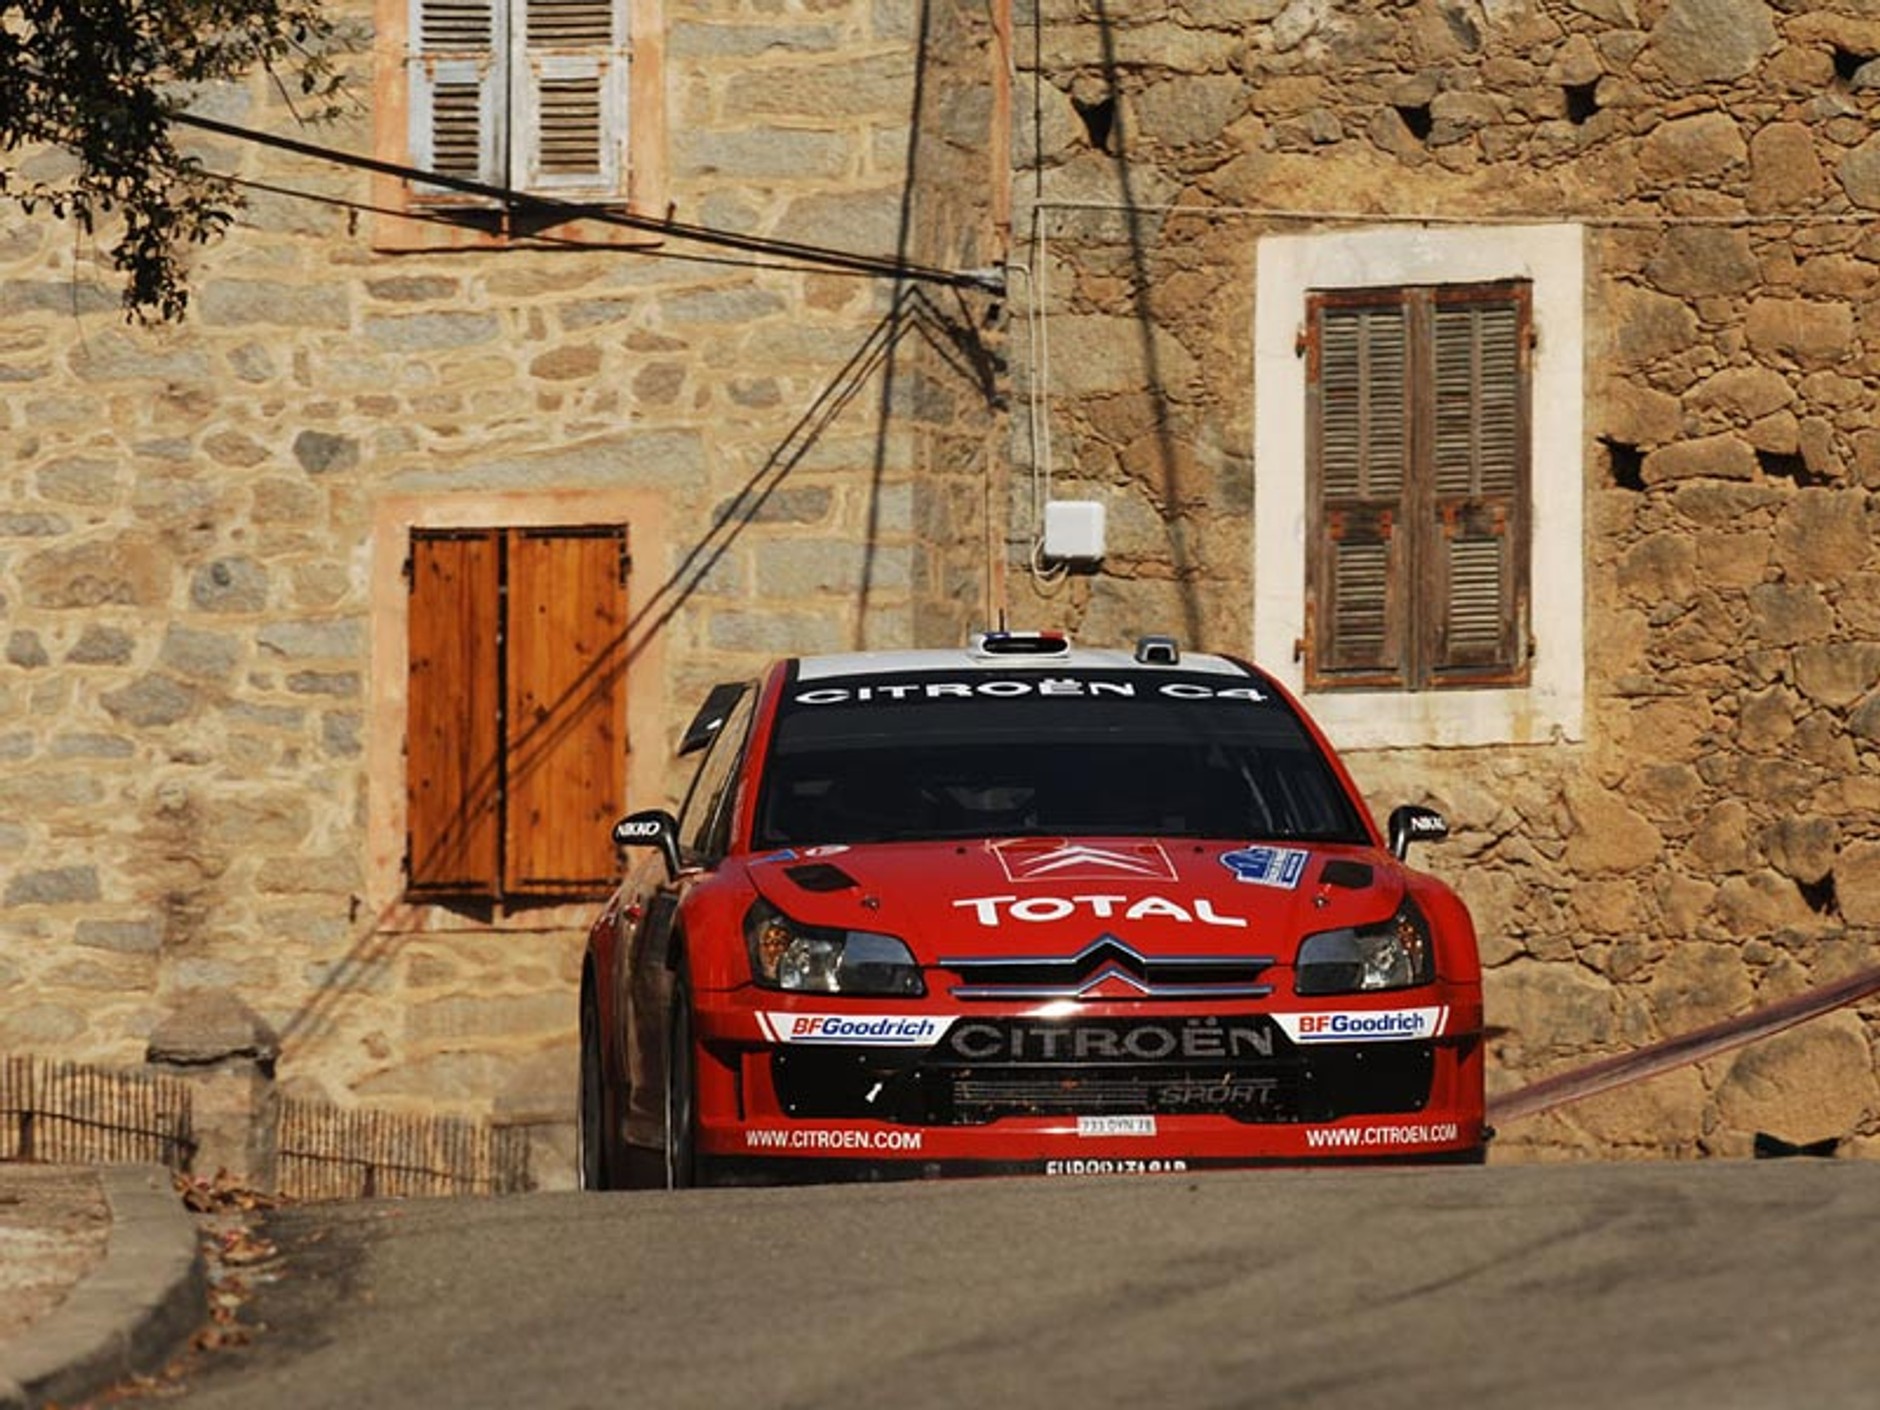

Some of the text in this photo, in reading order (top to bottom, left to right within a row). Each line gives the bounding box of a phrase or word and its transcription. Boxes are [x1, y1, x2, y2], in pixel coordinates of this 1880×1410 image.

[795, 678, 1268, 704] CITROËN C4
[952, 895, 1248, 927] TOTAL
[793, 1017, 935, 1036] BFGoodrich
[1299, 1013, 1424, 1033] BFGoodrich
[950, 1016, 1274, 1057] CITROËN
[1158, 1084, 1278, 1104] SPORT
[745, 1130, 923, 1149] WWW.CITROEN.COM
[1305, 1123, 1458, 1147] WWW.CITROEN.COM
